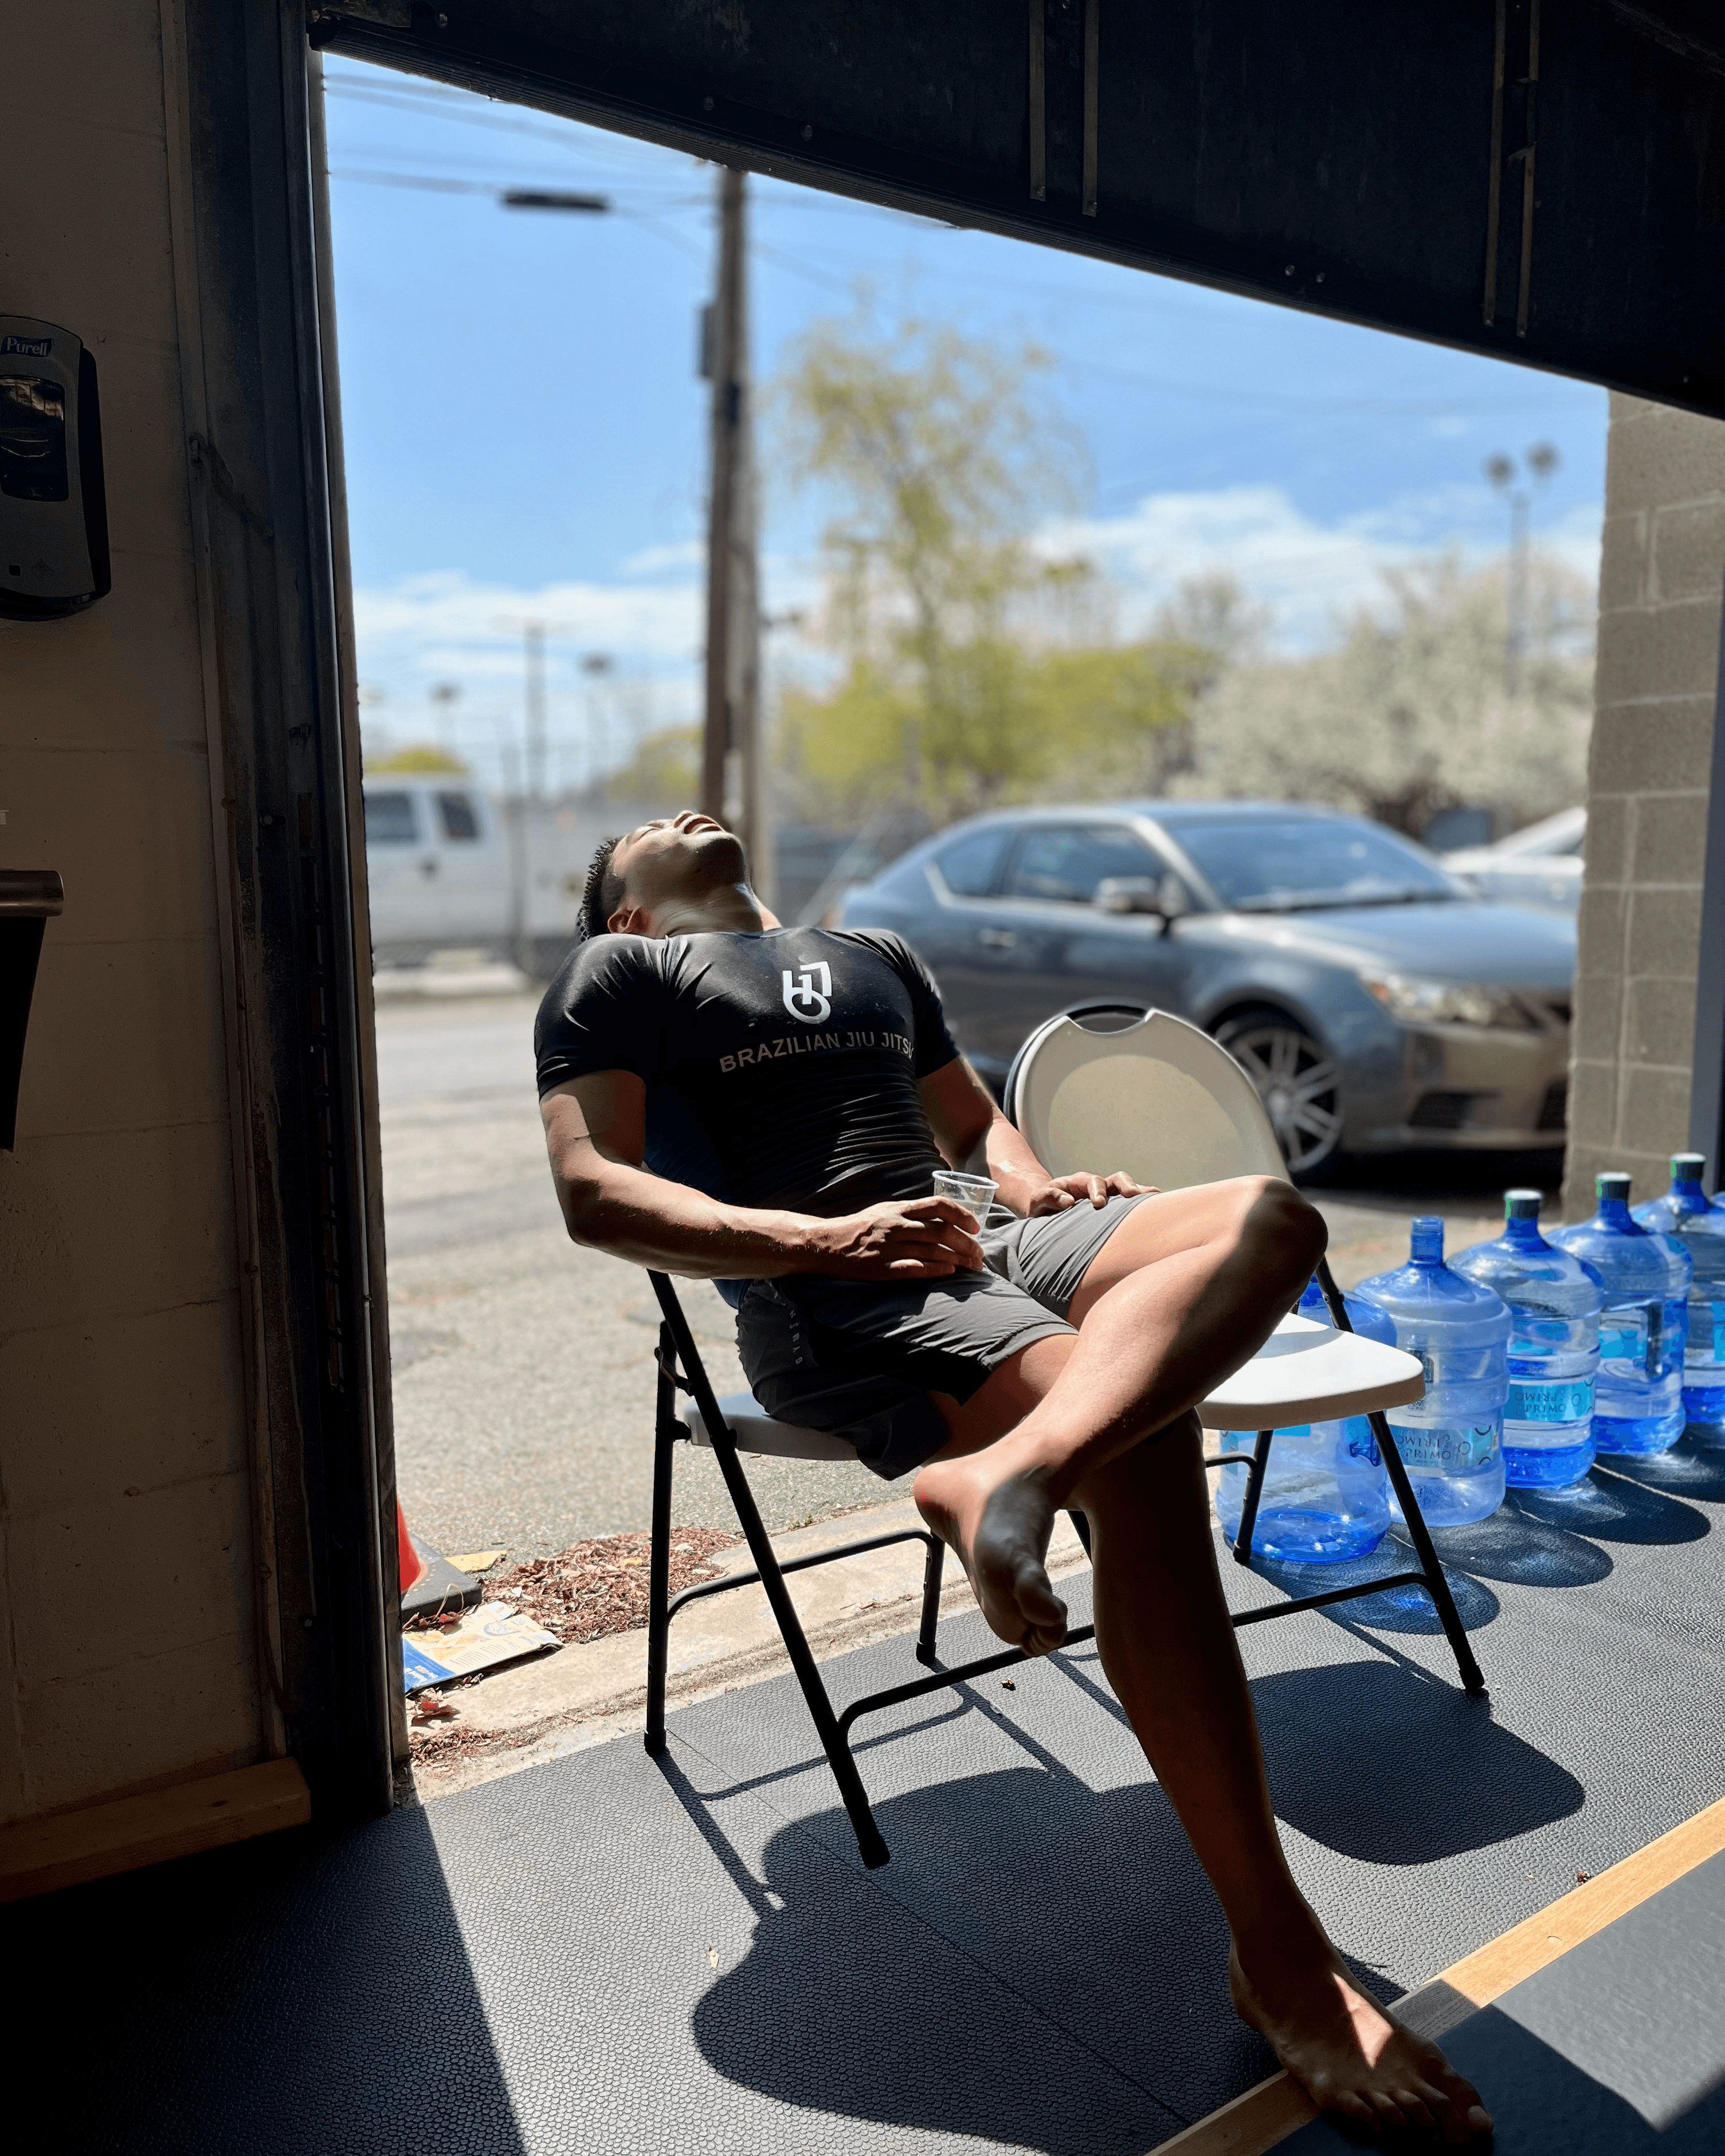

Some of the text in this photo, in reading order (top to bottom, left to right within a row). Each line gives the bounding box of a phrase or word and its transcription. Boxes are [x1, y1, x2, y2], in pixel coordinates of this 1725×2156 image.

[6, 337, 48, 356] Purell
[719, 1031, 915, 1073] BRAZILIAN JIU JITSU
[1526, 1403, 1566, 1413] PRIMO
[1406, 1448, 1452, 1460] PRIMO
